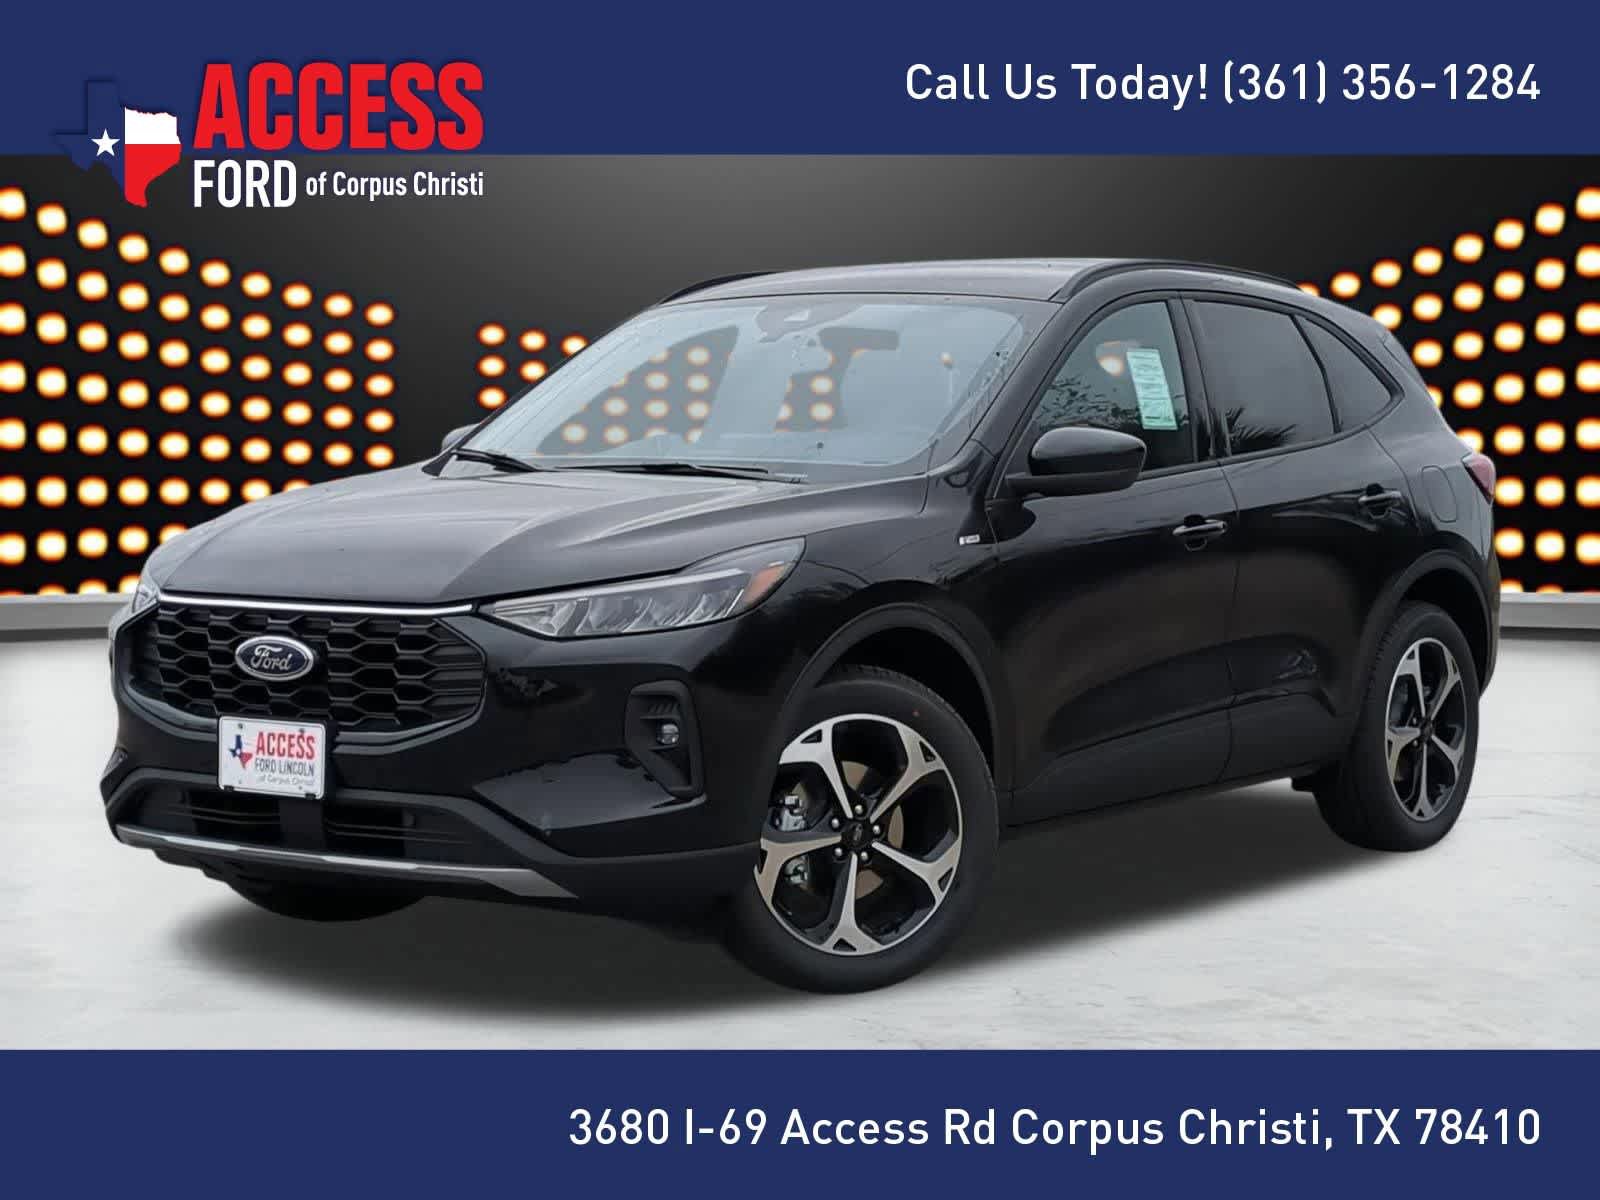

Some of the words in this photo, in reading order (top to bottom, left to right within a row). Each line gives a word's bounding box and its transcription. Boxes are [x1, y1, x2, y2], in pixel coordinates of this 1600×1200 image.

[250, 644, 293, 671] Ford
[255, 731, 316, 760] ACCESS
[255, 757, 277, 773] FORD
[279, 760, 315, 777] LINCOLN
